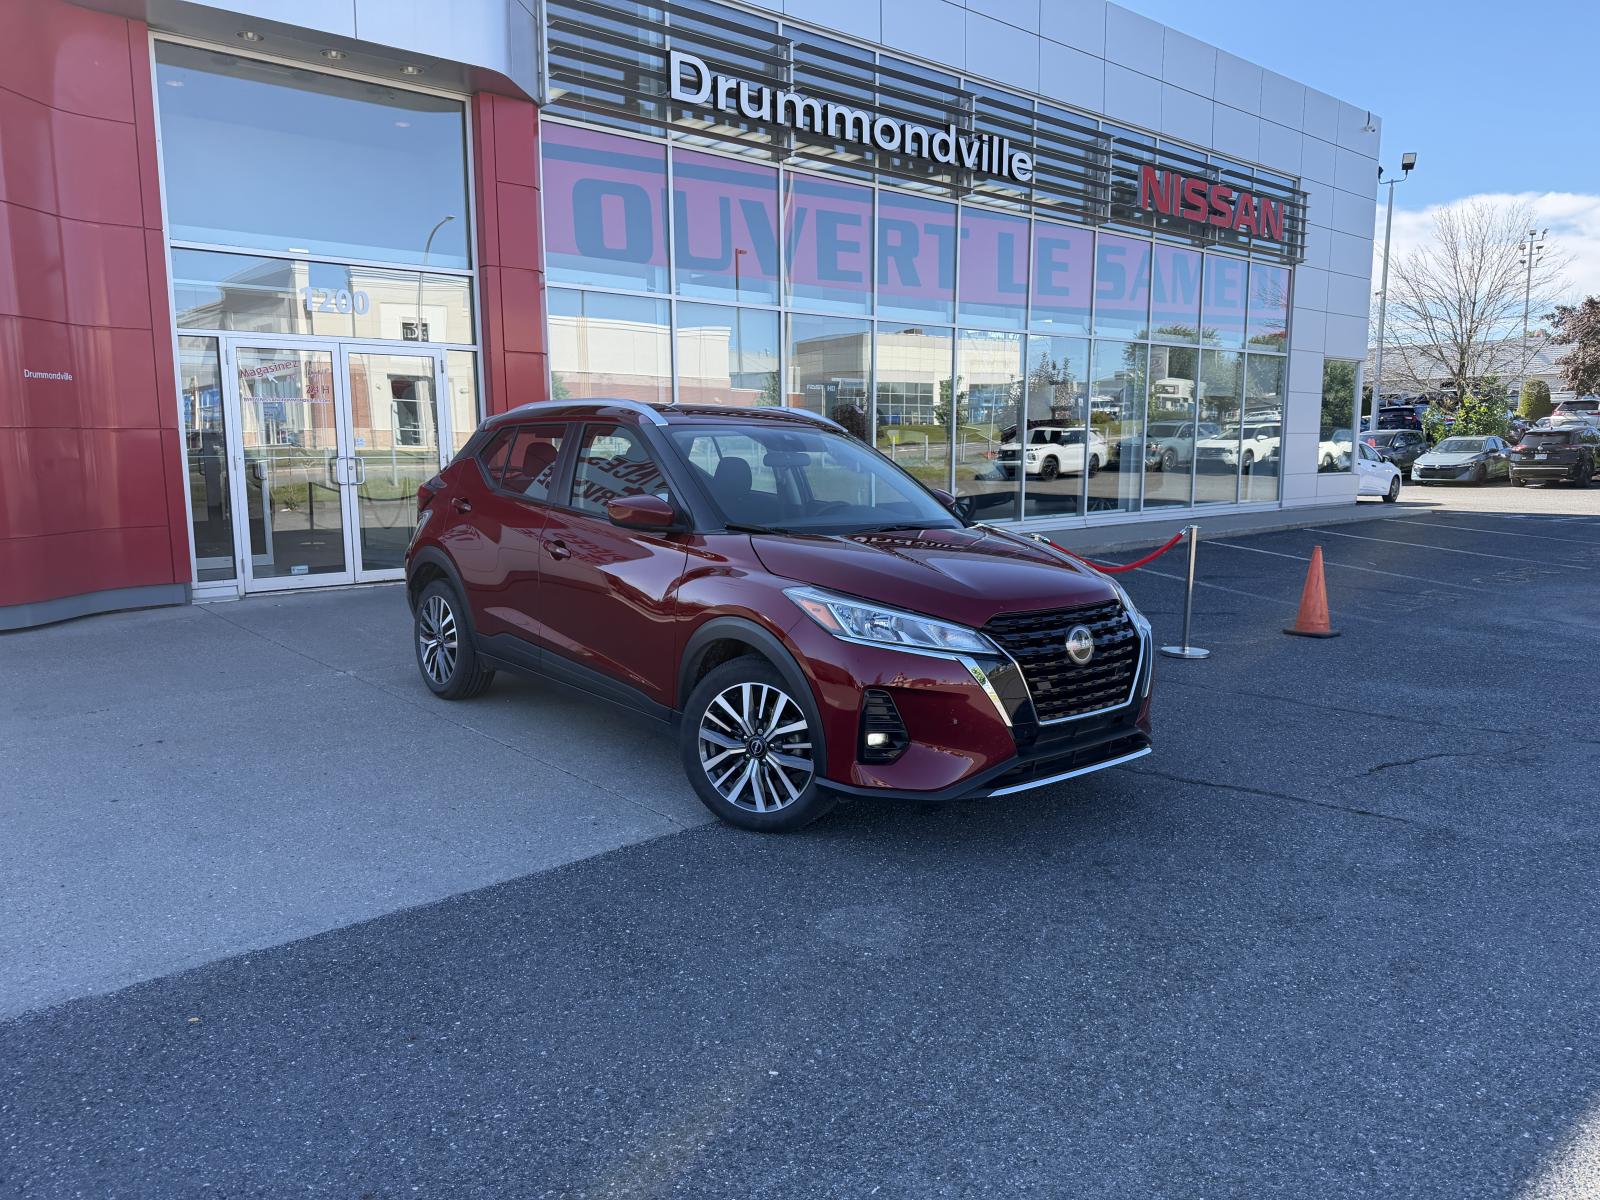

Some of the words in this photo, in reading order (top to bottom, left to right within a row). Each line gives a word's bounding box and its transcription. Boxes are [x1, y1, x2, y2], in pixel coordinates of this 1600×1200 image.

[669, 50, 1033, 181] Drummondville
[1139, 165, 1284, 241] NISSAN
[572, 178, 969, 290] OUVERT
[997, 222, 1071, 296] LE
[299, 287, 370, 316] 1200
[24, 369, 73, 381] Drummondville
[240, 360, 299, 378] Magasinez
